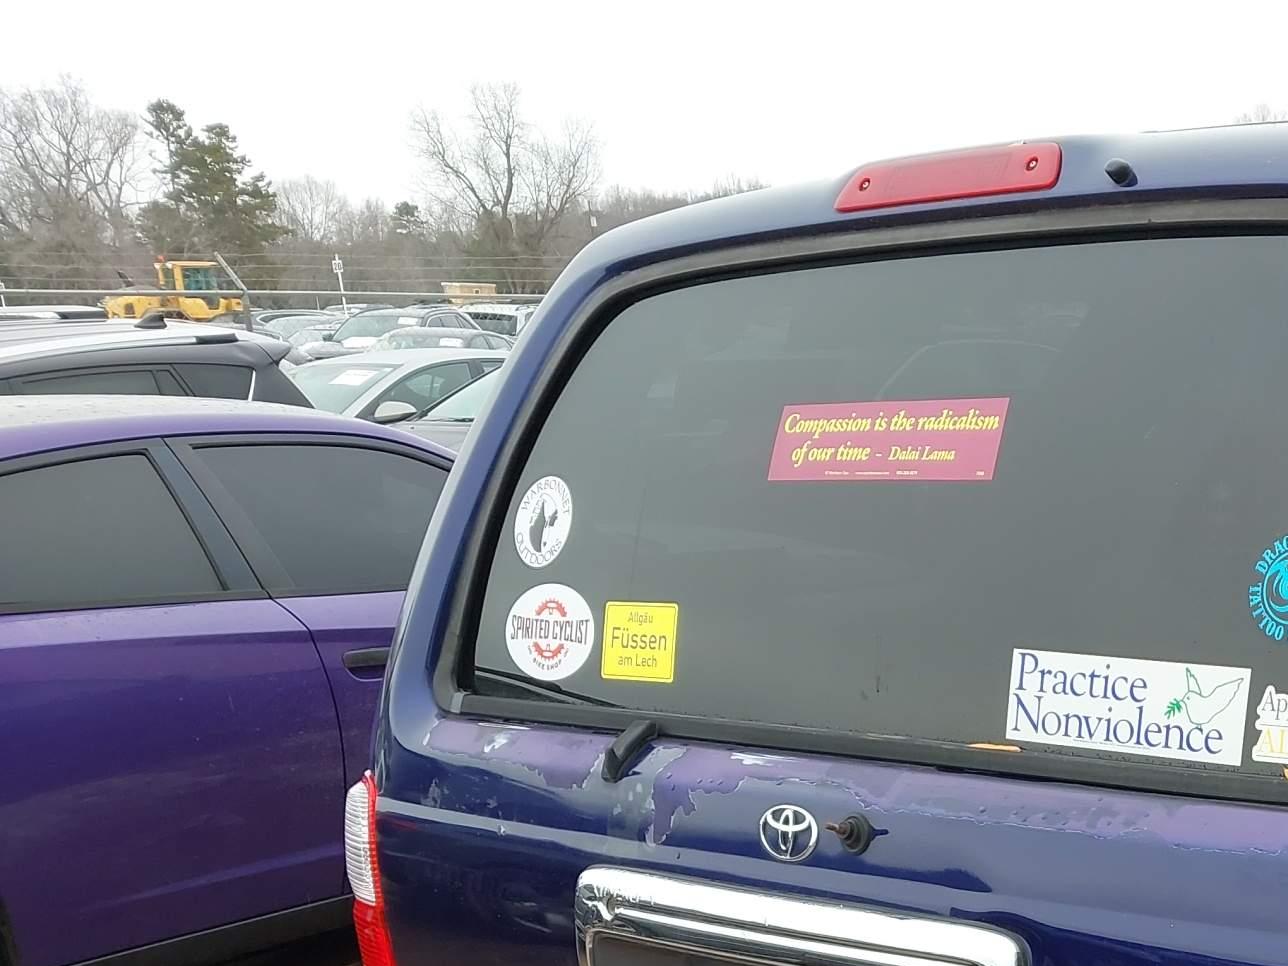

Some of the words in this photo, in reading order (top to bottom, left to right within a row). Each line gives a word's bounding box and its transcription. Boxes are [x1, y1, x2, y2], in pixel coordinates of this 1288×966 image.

[784, 413, 871, 438] Compassion
[874, 411, 886, 431] is
[889, 409, 914, 431] the
[917, 408, 1000, 431] radicalism
[791, 440, 811, 468] of
[808, 447, 835, 462] our
[836, 441, 871, 462] time
[888, 446, 921, 462] Dalai
[922, 446, 956, 462] Lama
[520, 479, 570, 514] WARBONNET
[516, 532, 563, 565] OUTDOORS
[627, 611, 654, 627] Allgäu
[1248, 582, 1285, 641] TATTOO
[510, 615, 549, 640] SPIRITED
[552, 618, 590, 646] CYCLIST
[610, 626, 668, 651] Füssen
[617, 655, 633, 667] am
[635, 653, 658, 668] Lech
[1016, 652, 1149, 703] Practice
[1012, 692, 1223, 756] Nonviolence
